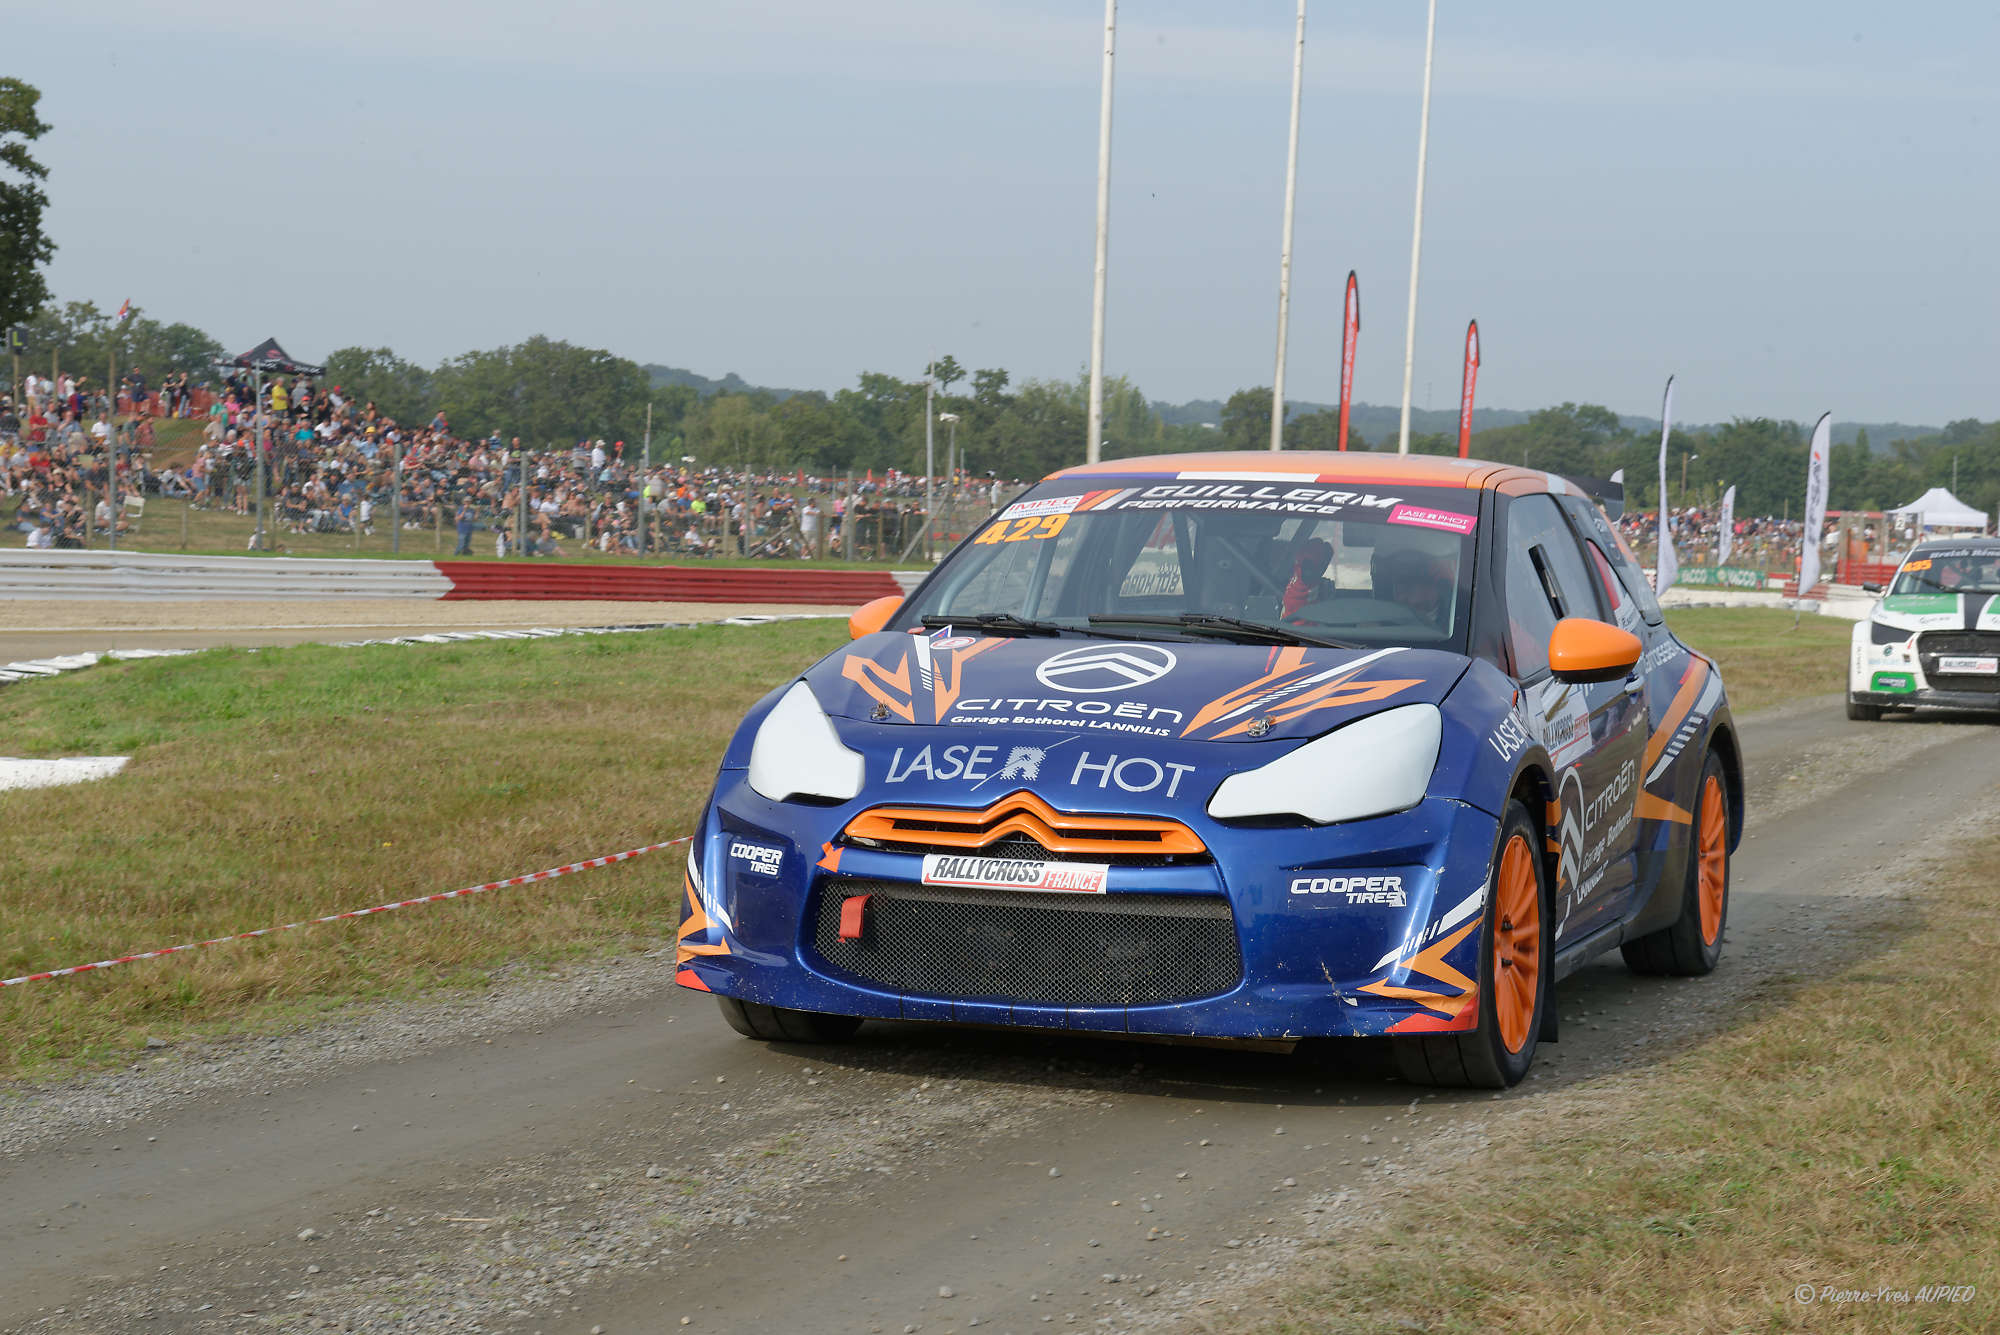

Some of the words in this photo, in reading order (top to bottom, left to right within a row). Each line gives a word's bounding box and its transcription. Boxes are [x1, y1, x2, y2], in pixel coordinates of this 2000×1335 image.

[12, 331, 24, 347] L
[1009, 496, 1080, 511] IMPEC
[1118, 499, 1343, 515] PERFORMANCE
[1140, 485, 1404, 509] GUILLERM
[973, 513, 1071, 545] 429
[950, 715, 1010, 725] Garage
[1012, 716, 1087, 728] Bothorel
[1088, 719, 1171, 737] LANNILIS
[1070, 751, 1196, 799] HOT
[730, 842, 783, 865] COOPER
[750, 860, 779, 876] TIRES
[933, 856, 1045, 883] RALLYCROSS
[1044, 871, 1102, 891] FRANCE
[1290, 876, 1402, 895] COOPER
[1345, 892, 1400, 905] TIRES
